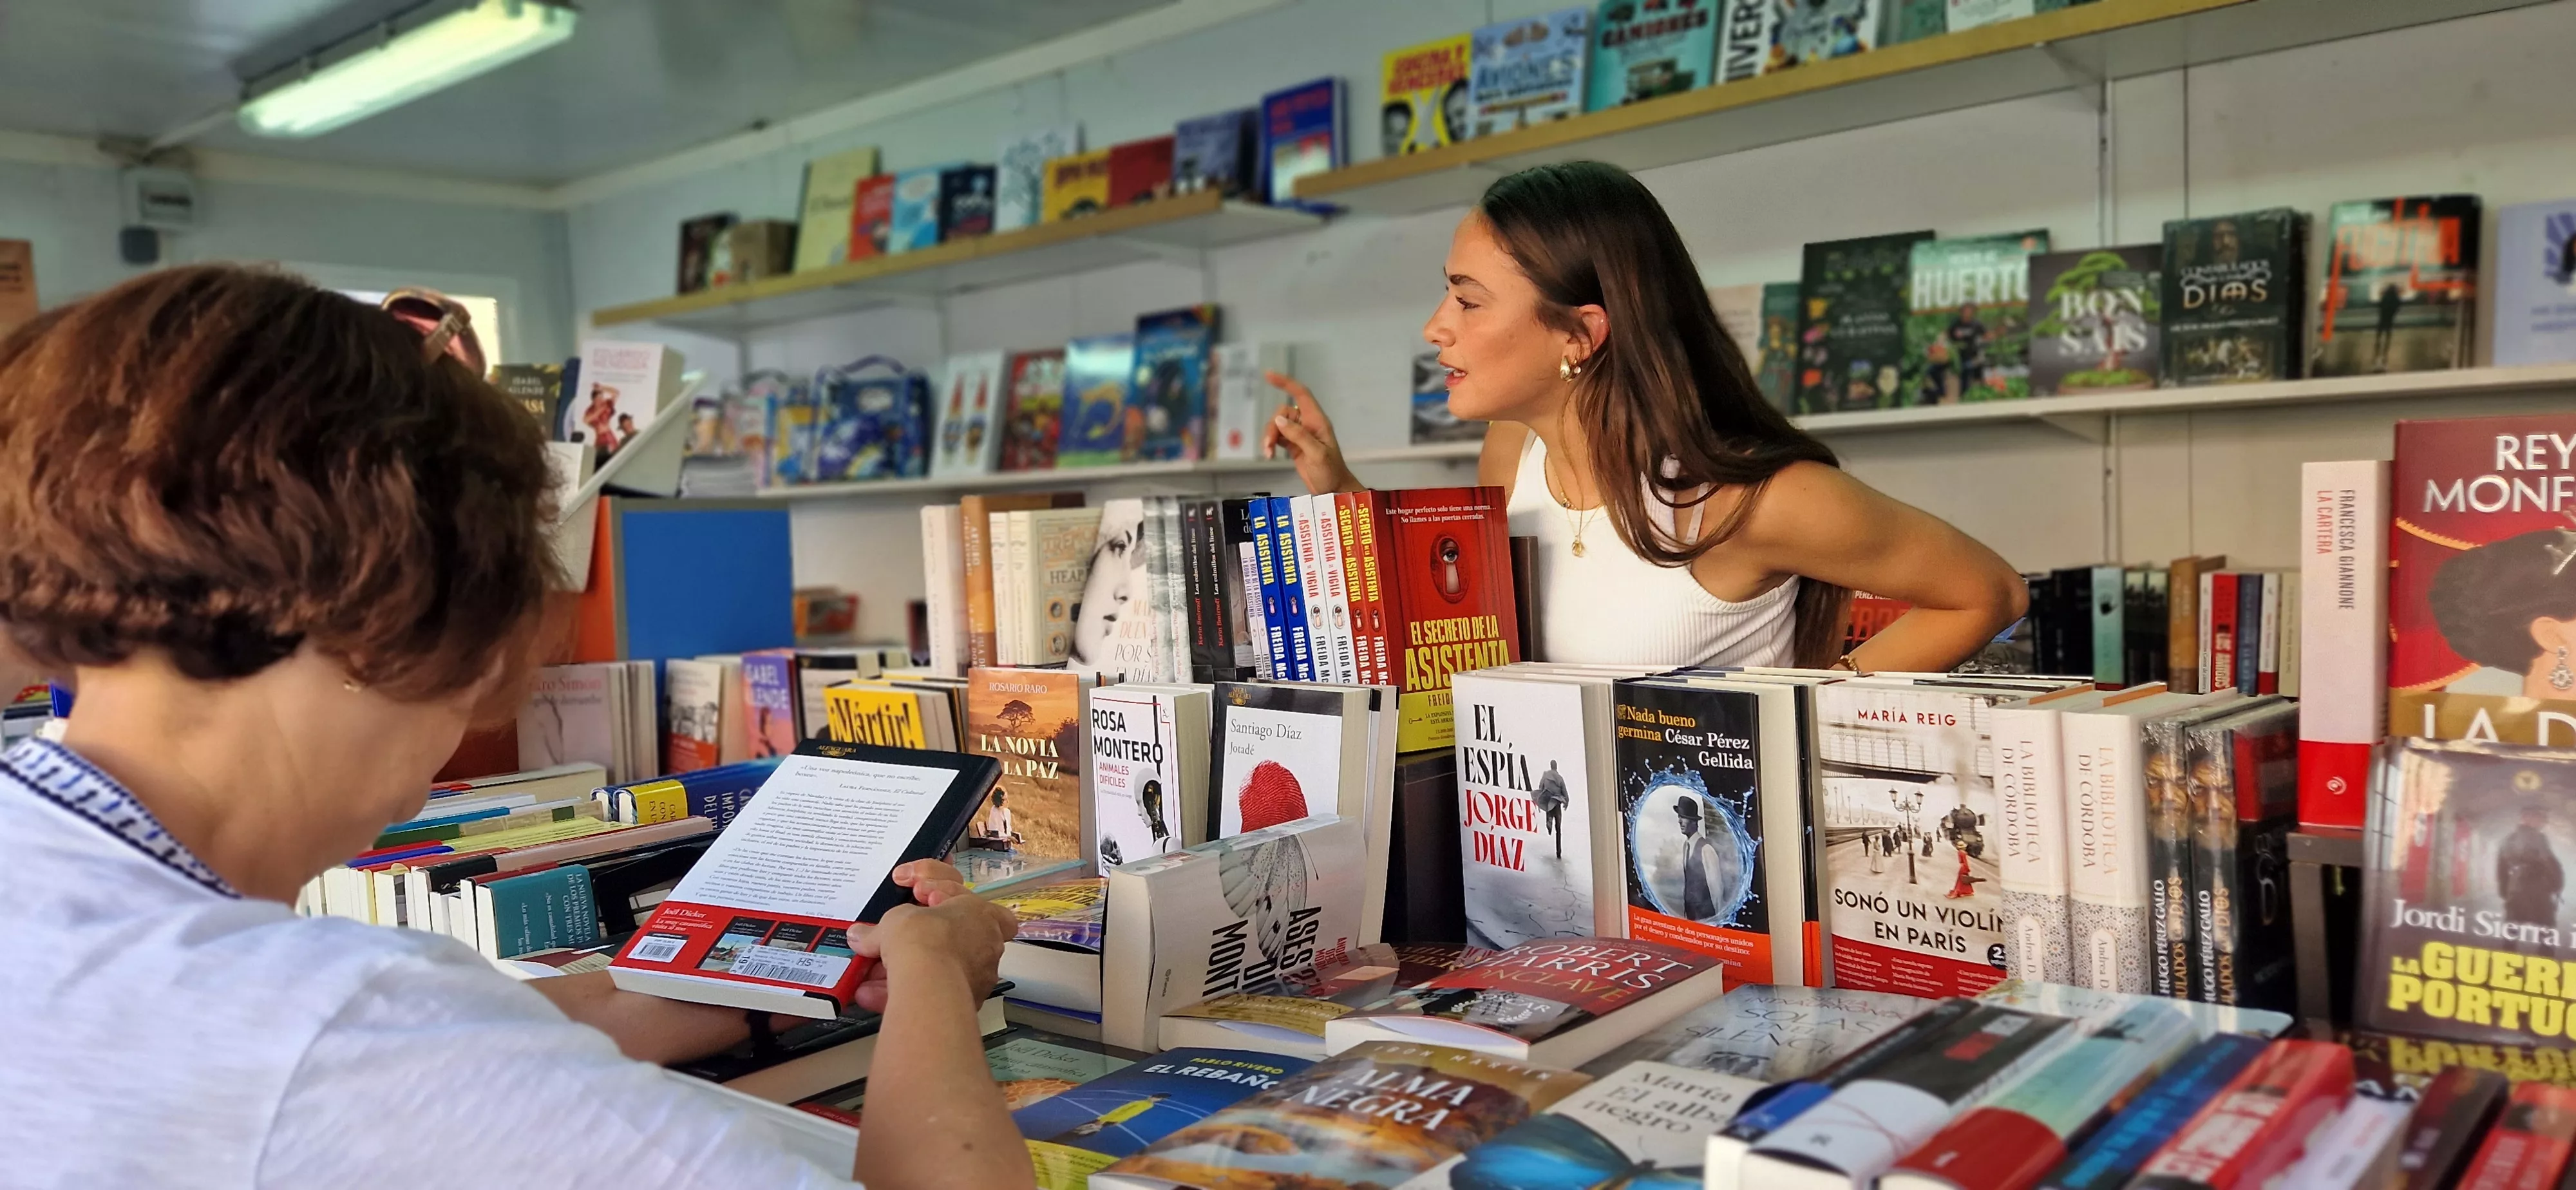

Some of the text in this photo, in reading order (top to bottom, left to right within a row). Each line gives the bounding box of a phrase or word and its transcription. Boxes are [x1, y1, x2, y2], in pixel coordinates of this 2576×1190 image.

[2061, 288, 2145, 320] BON
[2496, 435, 2576, 471] REY
[1397, 507, 1414, 515] hogar
[1415, 505, 1437, 515] perfecto
[2423, 475, 2576, 513] MONF
[1409, 515, 1427, 523] llames
[1441, 515, 1461, 523] puertas
[2316, 489, 2333, 554] LA CARTERA
[1253, 516, 1275, 585] LA ASISTENTA
[1276, 515, 1297, 585] LA ASISTENTA
[1298, 518, 1319, 598] ASISTENTA VIGILA
[1320, 518, 1341, 598] ASISTENTA VIGILA
[1339, 509, 1361, 603] SECRETO ASISTENTA
[1358, 507, 1379, 603] SECRETO ASISTENTA
[2338, 489, 2356, 610] FRANCESCA GIANNONE
[1270, 626, 1285, 661] FREIDA
[1292, 627, 1308, 661] FREIDA
[1410, 614, 1499, 645] EL SECRETO DE LA
[1315, 636, 1329, 667] FREIDA
[1336, 636, 1350, 667] FREIDA
[1356, 635, 1370, 668] FREIDA
[1373, 636, 1386, 669] FREIDA
[1405, 639, 1510, 692] ASISTENTA
[989, 682, 1048, 695] ROSARIO RARO
[1092, 708, 1127, 733] ROSA
[1230, 718, 1303, 741] Santiago Díaz
[1473, 704, 1502, 744] EL
[1627, 704, 1696, 729] Nada bueno
[1857, 706, 1956, 727] MARÍA REIG
[980, 733, 1059, 759] LA NOVIA
[1093, 735, 1164, 765] MONTERO
[1228, 741, 1255, 756] Jotadé
[1617, 722, 1750, 751] germina César Pérez
[1003, 759, 1059, 780] LA PAZ
[1099, 761, 1130, 776] ANIMALES
[1463, 741, 1533, 793] ESPÍA
[1697, 750, 1755, 771] Gellida
[1463, 789, 1539, 834] JORGE
[2002, 747, 2020, 858] DE CÓRDOBA
[2020, 740, 2041, 864] LA BIBLIOTECA
[2078, 753, 2096, 869] DE CÓRDOBA
[2099, 747, 2117, 875] LA BIBLIOTECA
[1473, 825, 1526, 873] DÍAZ
[567, 873, 578, 900] DE LOS
[575, 873, 592, 941] LA NUEVA NOVELA
[661, 907, 707, 918] Joël Dicker
[1833, 887, 1890, 915] SONÓ
[1896, 900, 1927, 921] UN
[1633, 912, 1640, 921] La
[1640, 916, 1652, 925] gran
[1652, 920, 1676, 932] aventura
[1685, 927, 1696, 936] dos
[1696, 931, 1730, 945] personajes
[1730, 938, 1754, 948] unidos
[1634, 923, 1643, 931] por
[1649, 926, 1665, 937] deseo
[1669, 933, 1703, 946] condenados
[1703, 941, 1714, 949] por
[1873, 921, 1967, 954] EN PARÍS
[2153, 879, 2171, 995] HUGO PÉREZ GALLO
[2198, 889, 2215, 968] PÉREZ GALLO
[2390, 899, 2561, 948] Jordi Sierra
[1503, 943, 1694, 978] ROBERT
[2023, 925, 2034, 962] Andrea
[2096, 938, 2110, 976] Andrea
[1464, 956, 1665, 990] HARRIS
[2391, 956, 2421, 976] LA
[1143, 1064, 1175, 1074] EL
[1189, 1057, 1285, 1075] PABLO RIVERO
[1374, 1046, 1435, 1058] IBON
[1337, 1068, 1475, 1107] ALMA
[1606, 1085, 1653, 1103] El
[1629, 1072, 1734, 1103] María
[1301, 1084, 1451, 1131] NEGRA
[1582, 1100, 1692, 1134] negro
